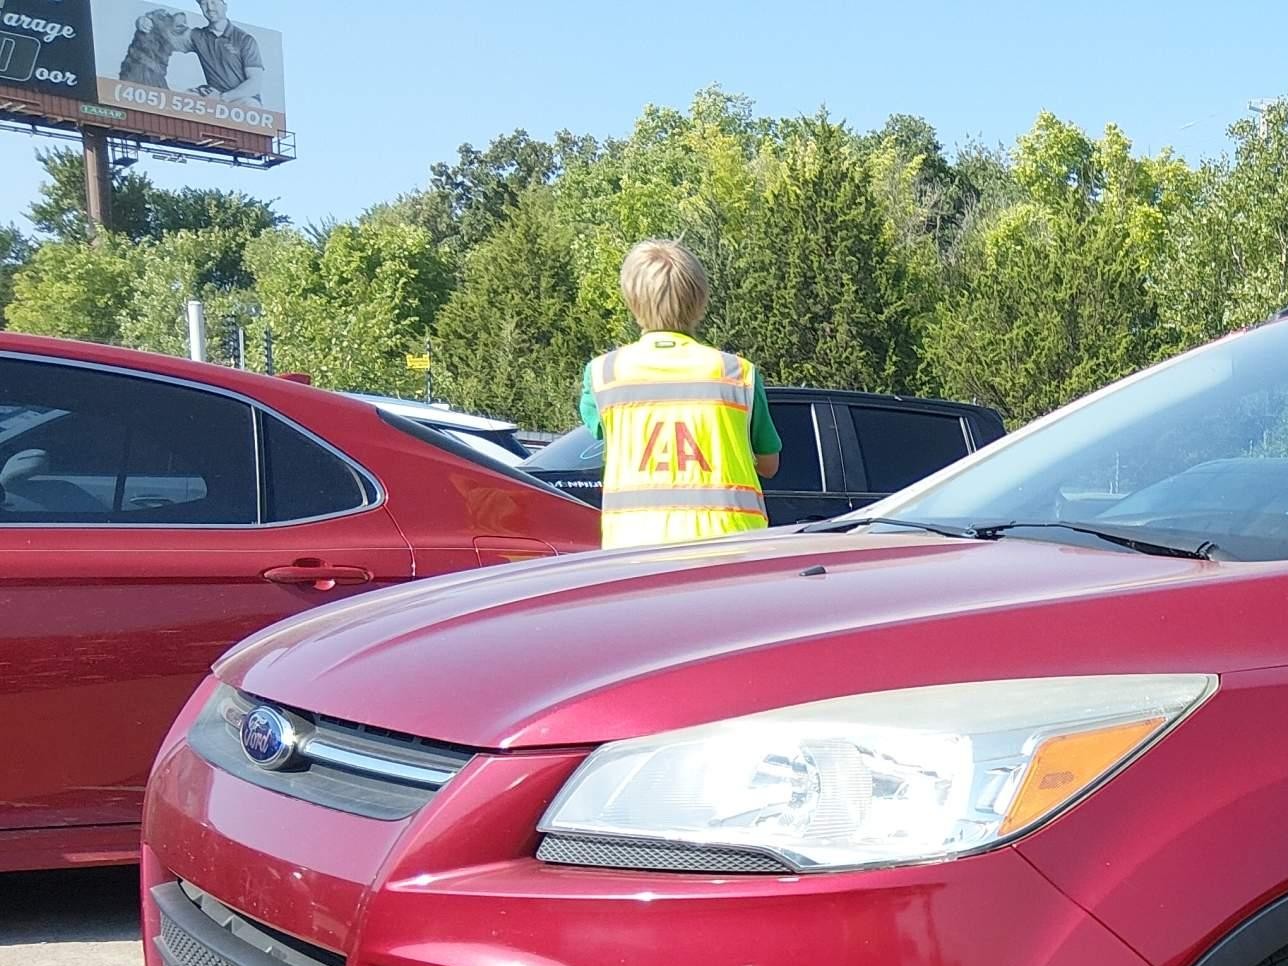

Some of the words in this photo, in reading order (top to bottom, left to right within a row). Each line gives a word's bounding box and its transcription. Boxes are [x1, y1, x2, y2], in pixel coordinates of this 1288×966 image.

[114, 84, 166, 110] (405)
[172, 96, 274, 129] 525-DOOR
[243, 713, 273, 754] Ford
